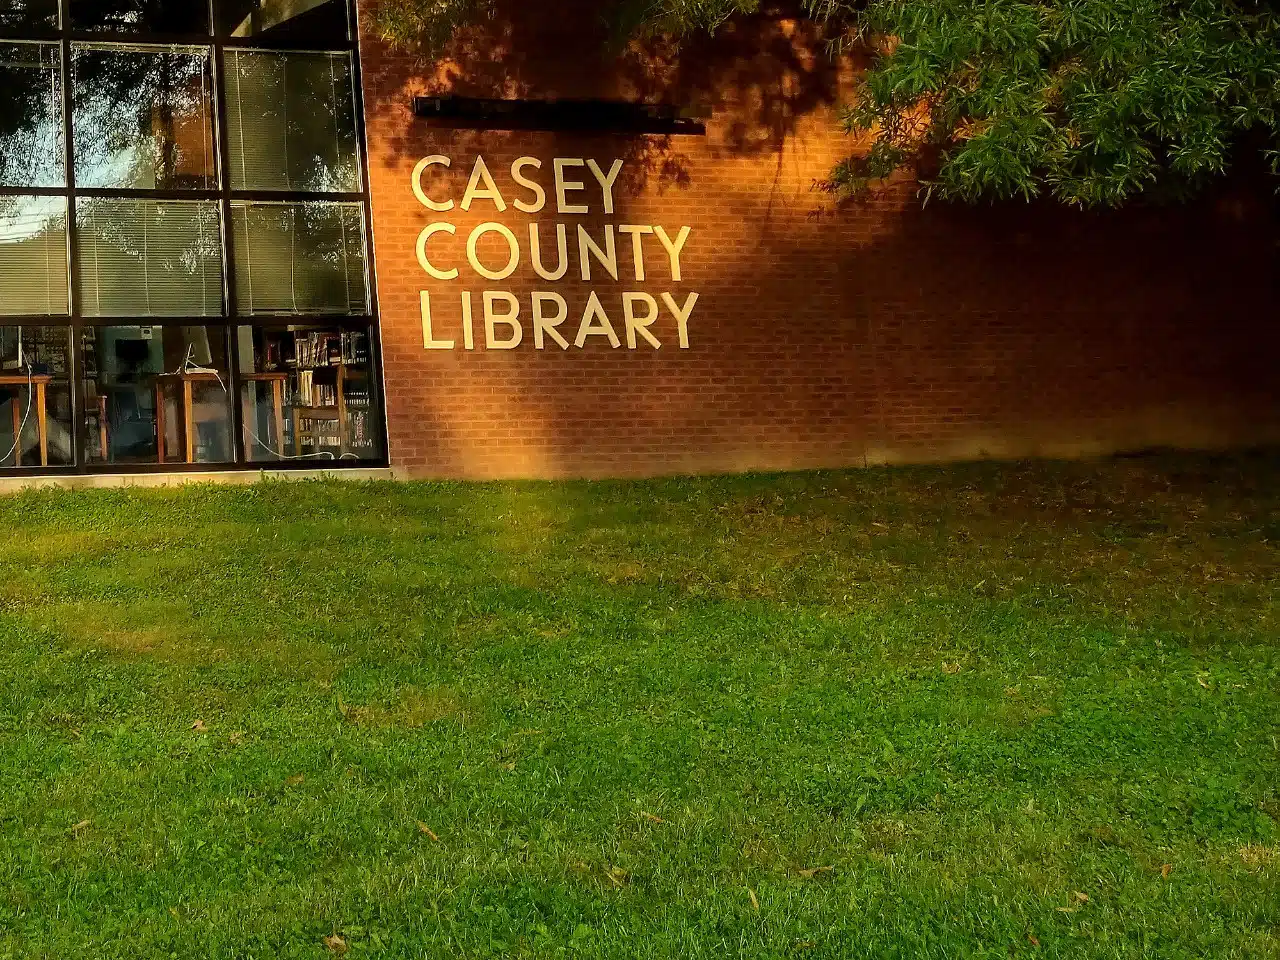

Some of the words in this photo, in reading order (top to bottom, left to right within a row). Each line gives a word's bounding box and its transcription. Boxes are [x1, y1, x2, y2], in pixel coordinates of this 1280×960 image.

[410, 154, 624, 214] CASEY
[415, 221, 691, 282] COUNTY
[419, 290, 700, 350] LIBRARY
